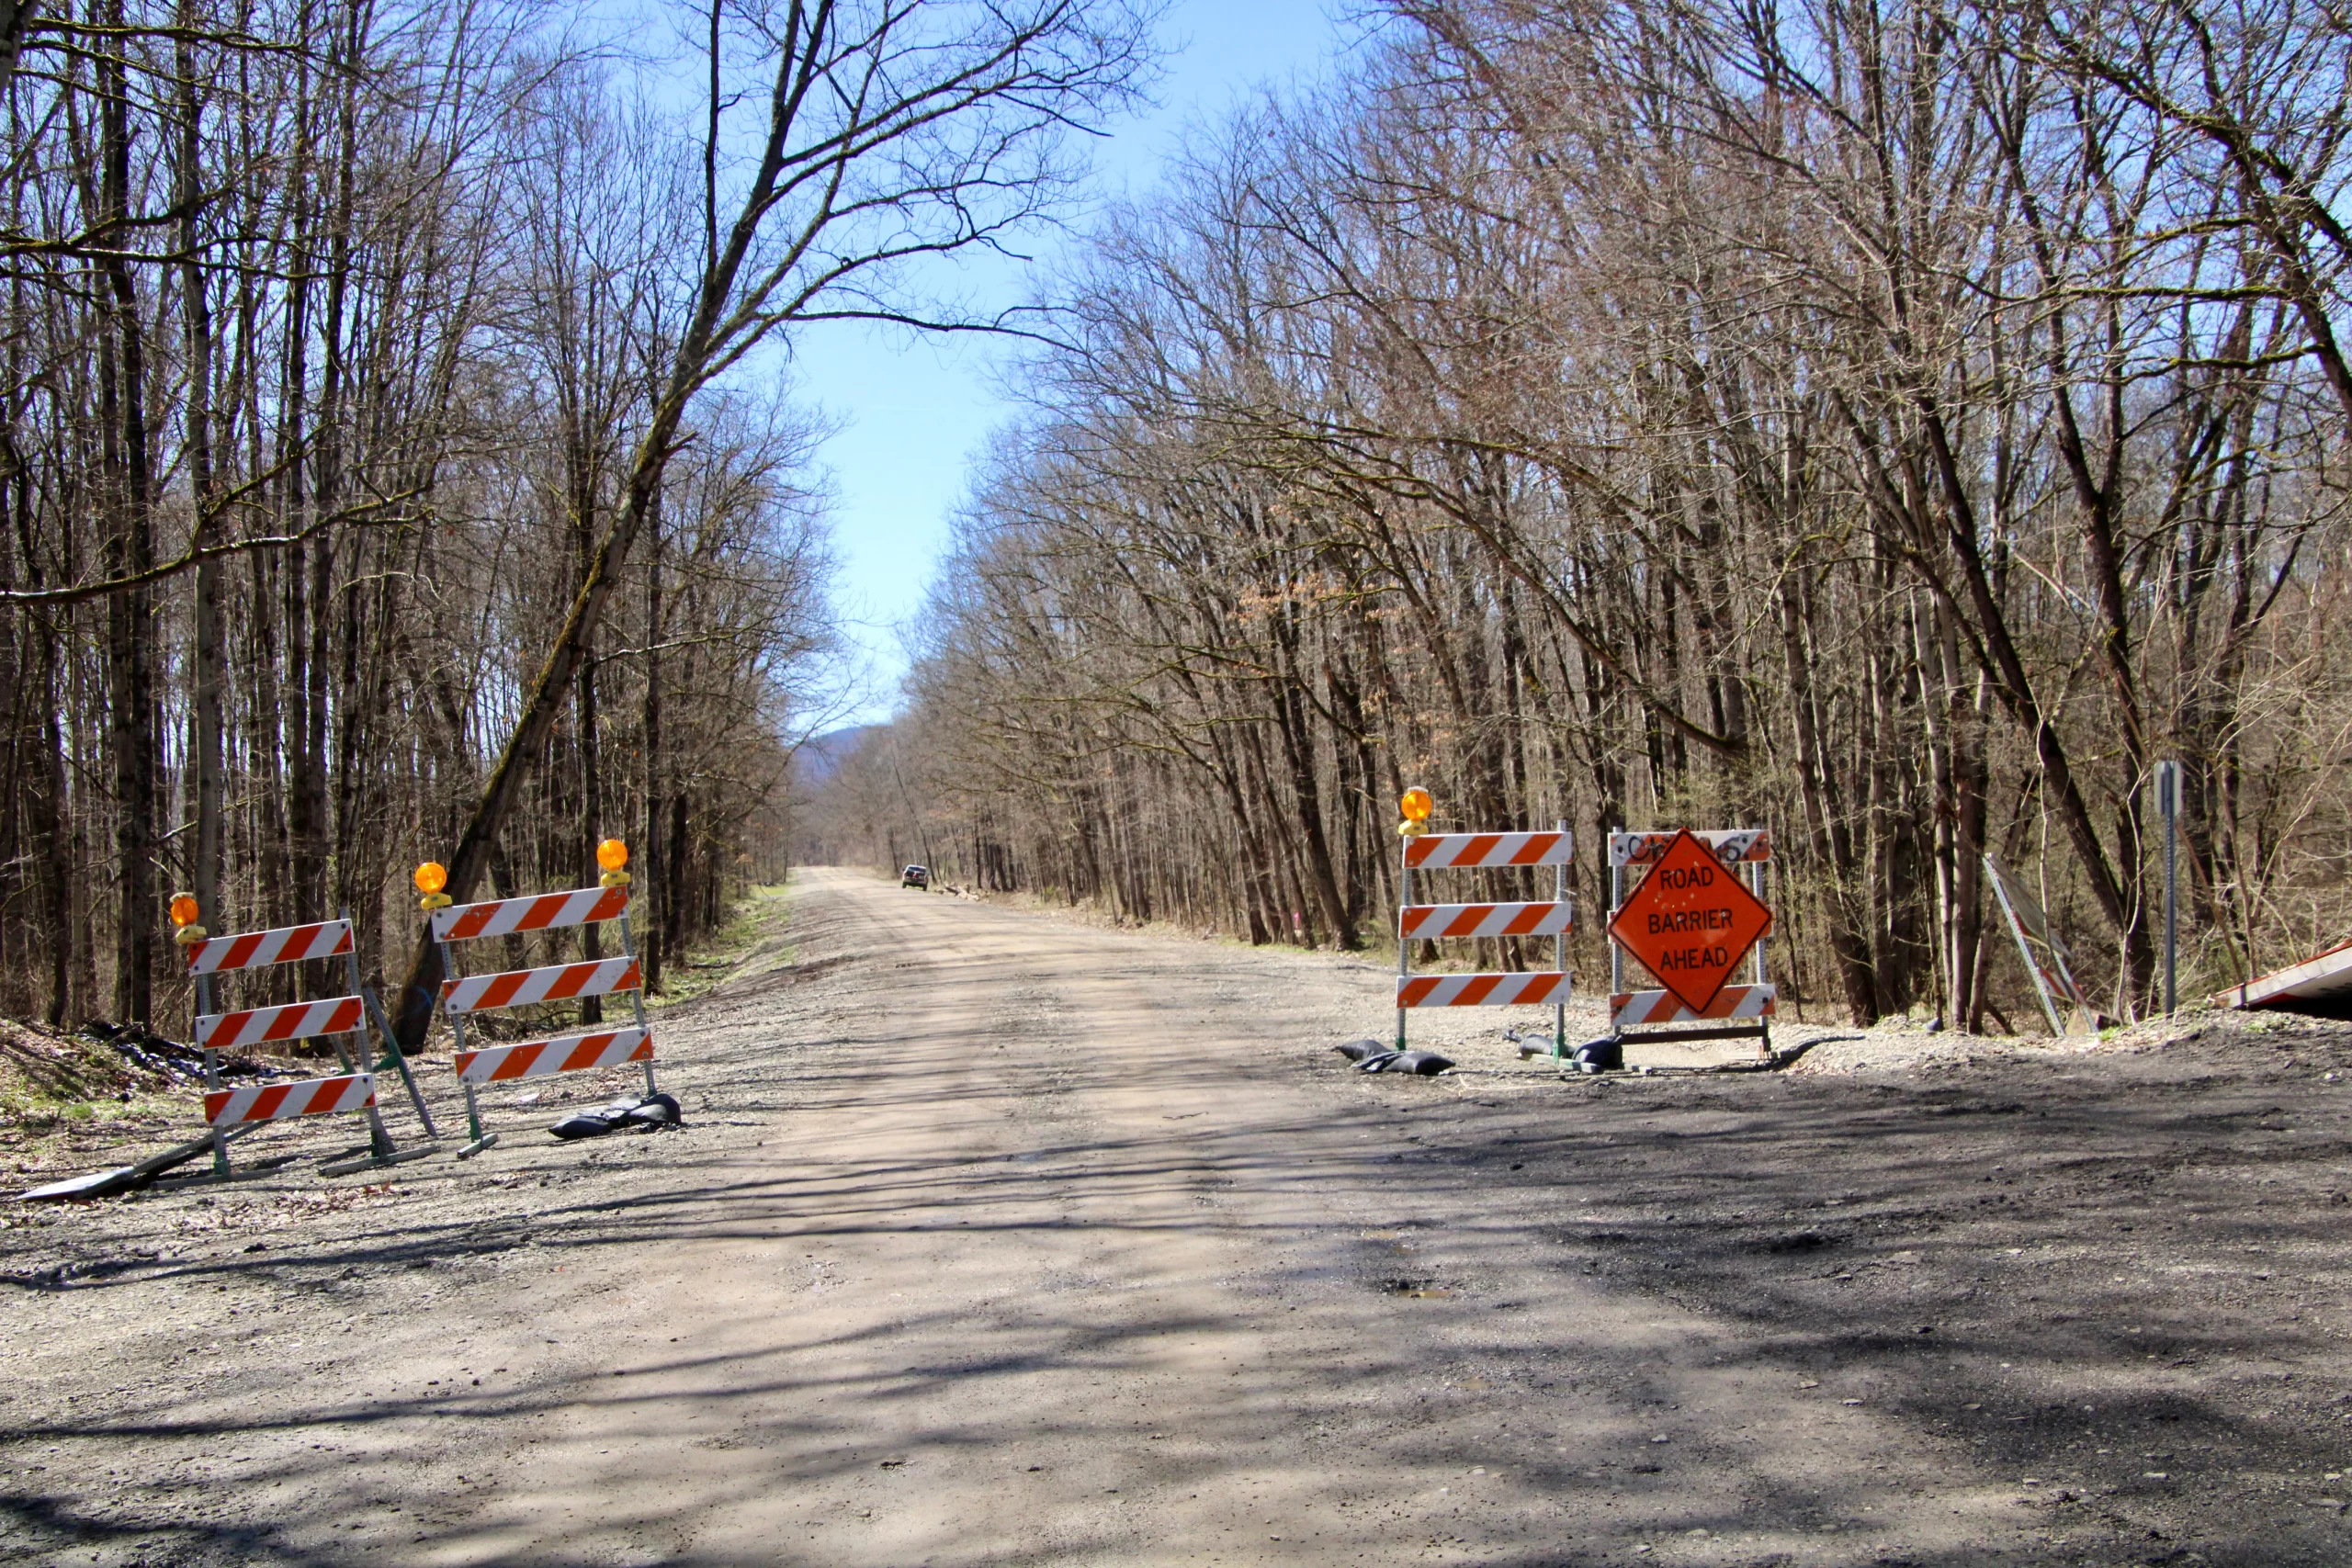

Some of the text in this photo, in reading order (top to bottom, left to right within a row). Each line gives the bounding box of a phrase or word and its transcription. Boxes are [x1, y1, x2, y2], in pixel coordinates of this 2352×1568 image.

[1659, 866, 1714, 890] ROAD
[1647, 908, 1734, 934] BARRIER
[1659, 946, 1728, 971] AHEAD
